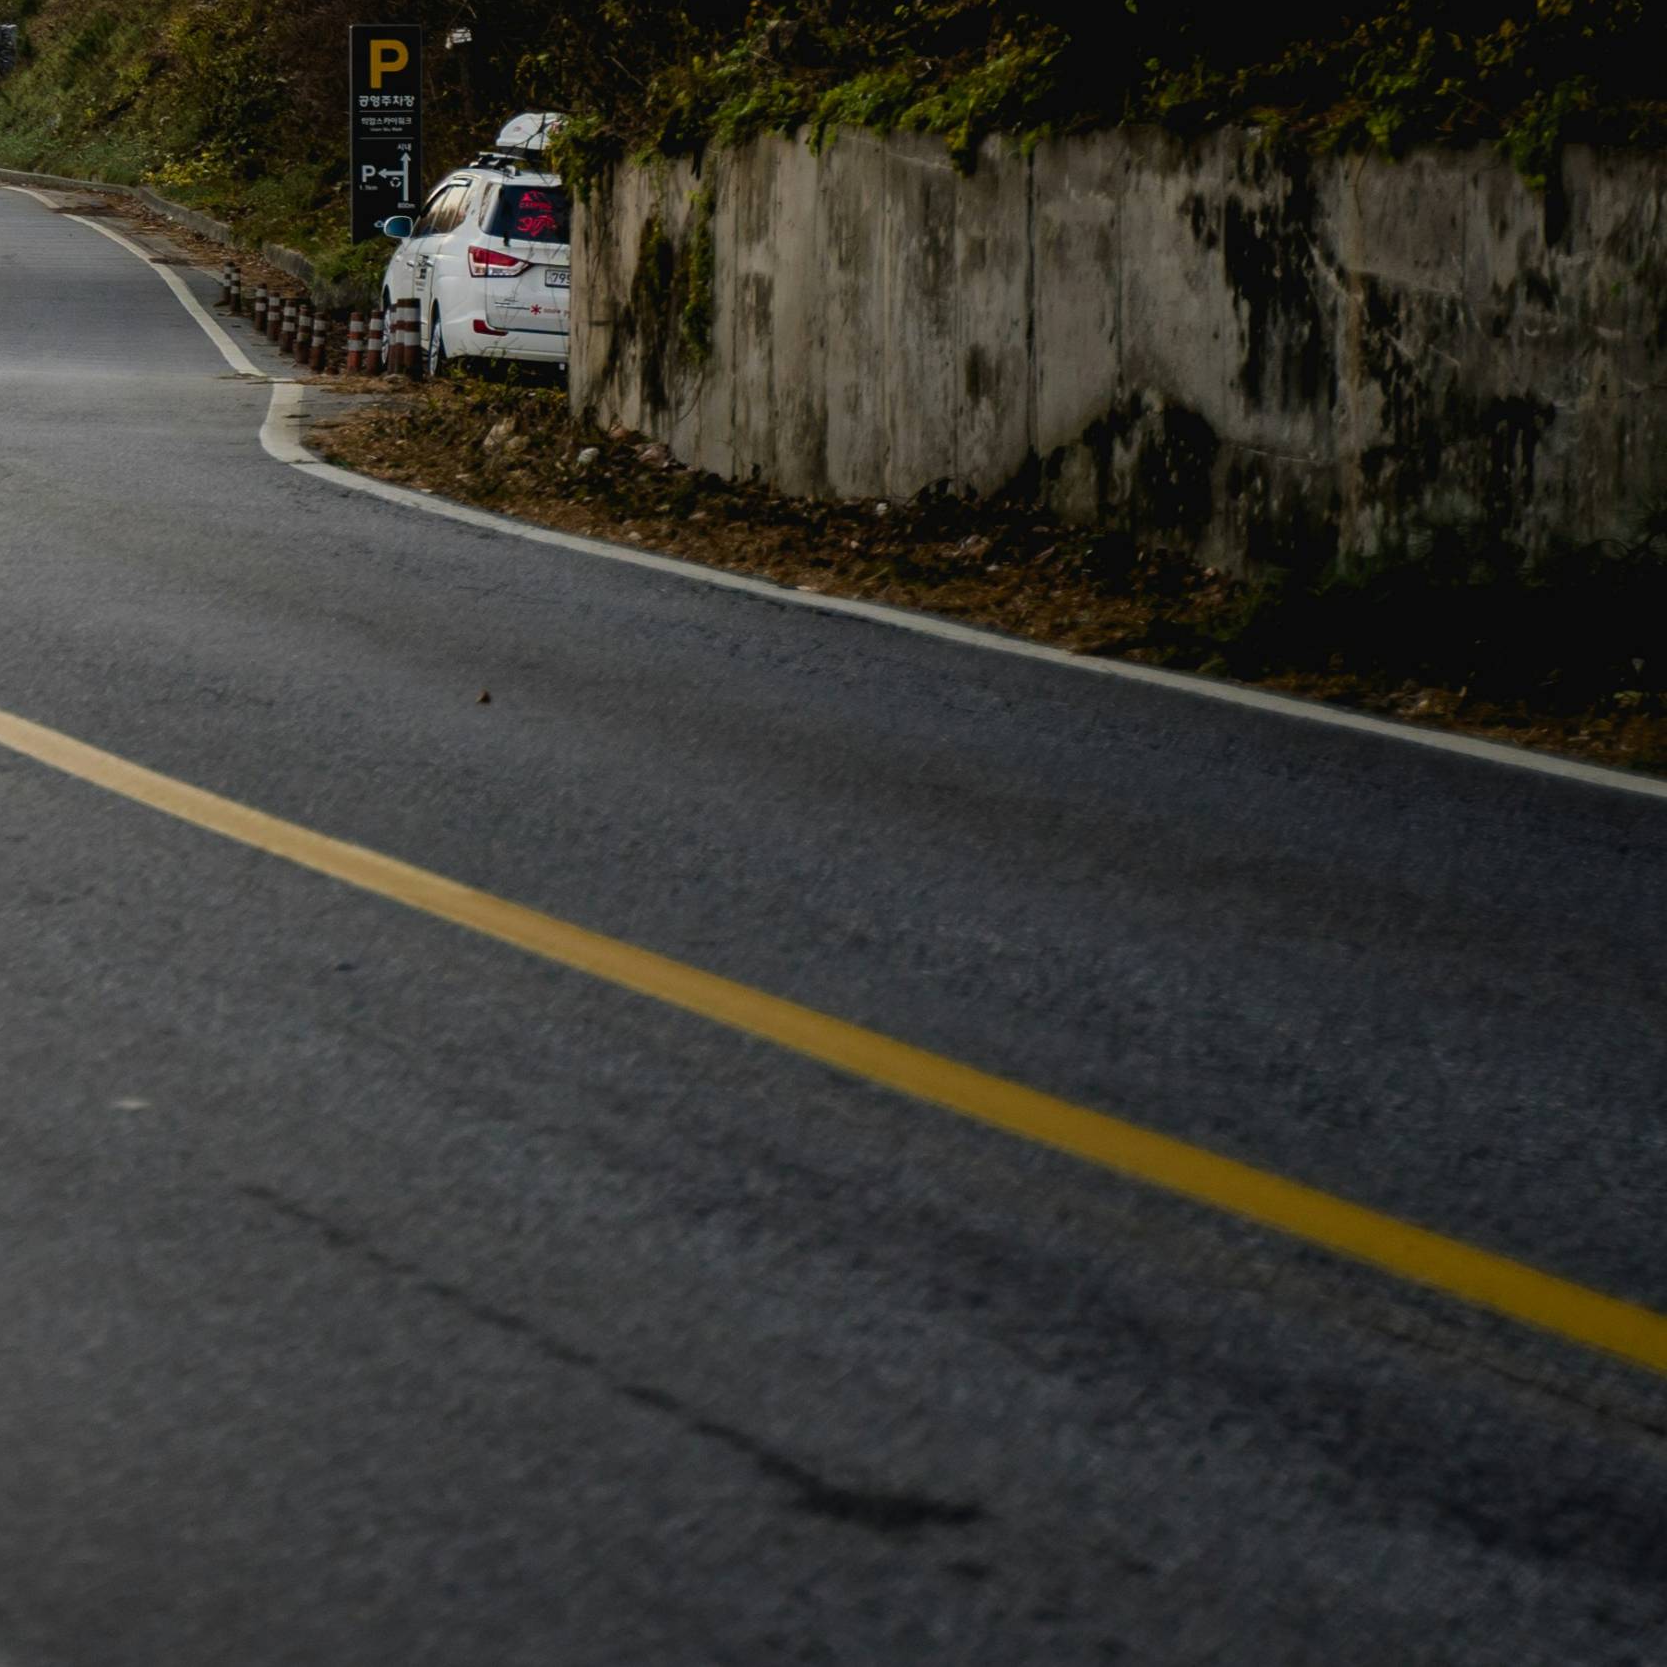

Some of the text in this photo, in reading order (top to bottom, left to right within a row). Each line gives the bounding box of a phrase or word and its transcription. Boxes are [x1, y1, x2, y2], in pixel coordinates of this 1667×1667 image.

[369, 39, 409, 89] P
[358, 95, 415, 108] 공영주차장
[361, 164, 376, 183] P
